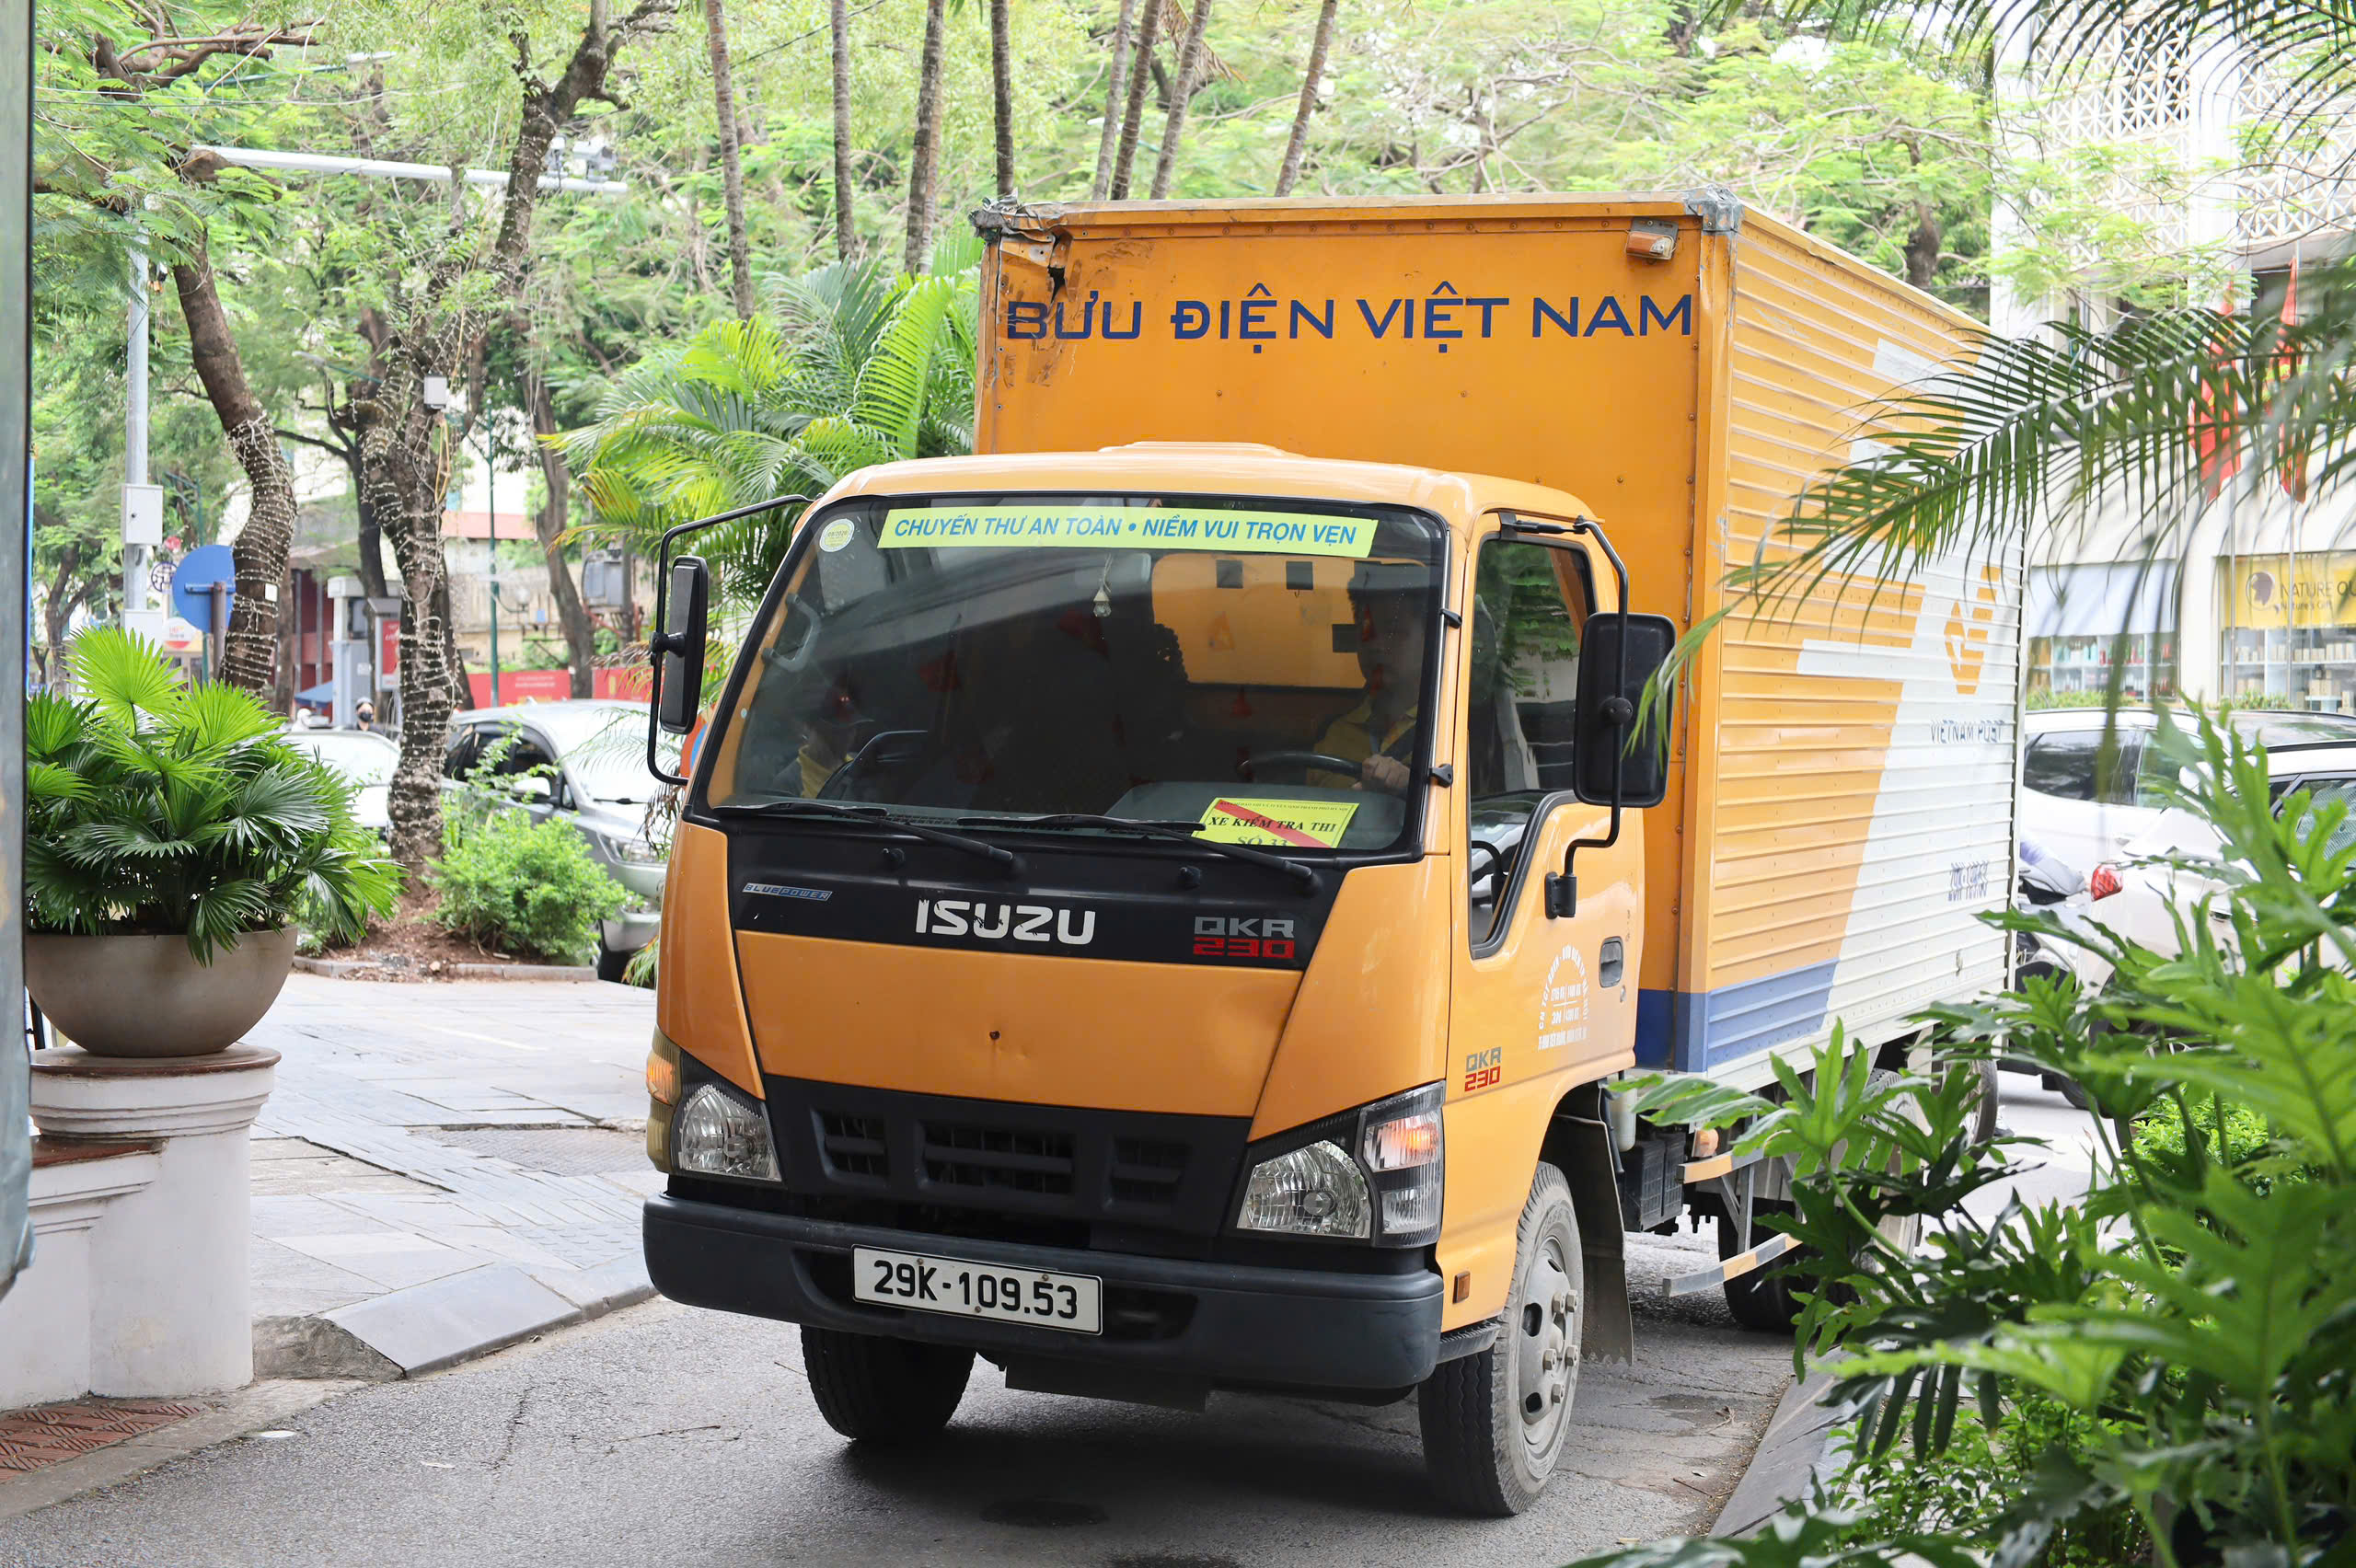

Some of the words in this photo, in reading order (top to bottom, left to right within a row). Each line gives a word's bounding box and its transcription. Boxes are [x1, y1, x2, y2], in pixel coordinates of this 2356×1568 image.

[1007, 290, 1141, 340] BƯU
[1171, 282, 1334, 353] ĐIỆN
[1356, 281, 1509, 353] VIỆT
[1532, 294, 1692, 338] NAM
[895, 513, 977, 536] CHUYẾN
[985, 515, 1027, 536] THƯ
[1028, 517, 1059, 536] AN
[1066, 514, 1123, 536] TOÀN
[1142, 514, 1198, 537] NIỀM
[1204, 520, 1240, 539] VUI
[1246, 521, 1307, 545] TRỌN
[1312, 524, 1357, 547] VẸN
[1930, 720, 1974, 744] VIETNAM
[1207, 816, 1230, 827] XE
[1231, 815, 1273, 829] KIỂM
[1276, 820, 1305, 832] TRA
[1311, 822, 1337, 833] THI
[744, 883, 830, 900] BLUEPOWER
[916, 899, 1096, 945] ISUZU
[1195, 917, 1295, 939] QKR
[1193, 937, 1295, 959] 230
[1465, 1046, 1502, 1073] QKR
[1464, 1066, 1501, 1092] 230
[873, 1259, 1078, 1320] 29K-109.53
